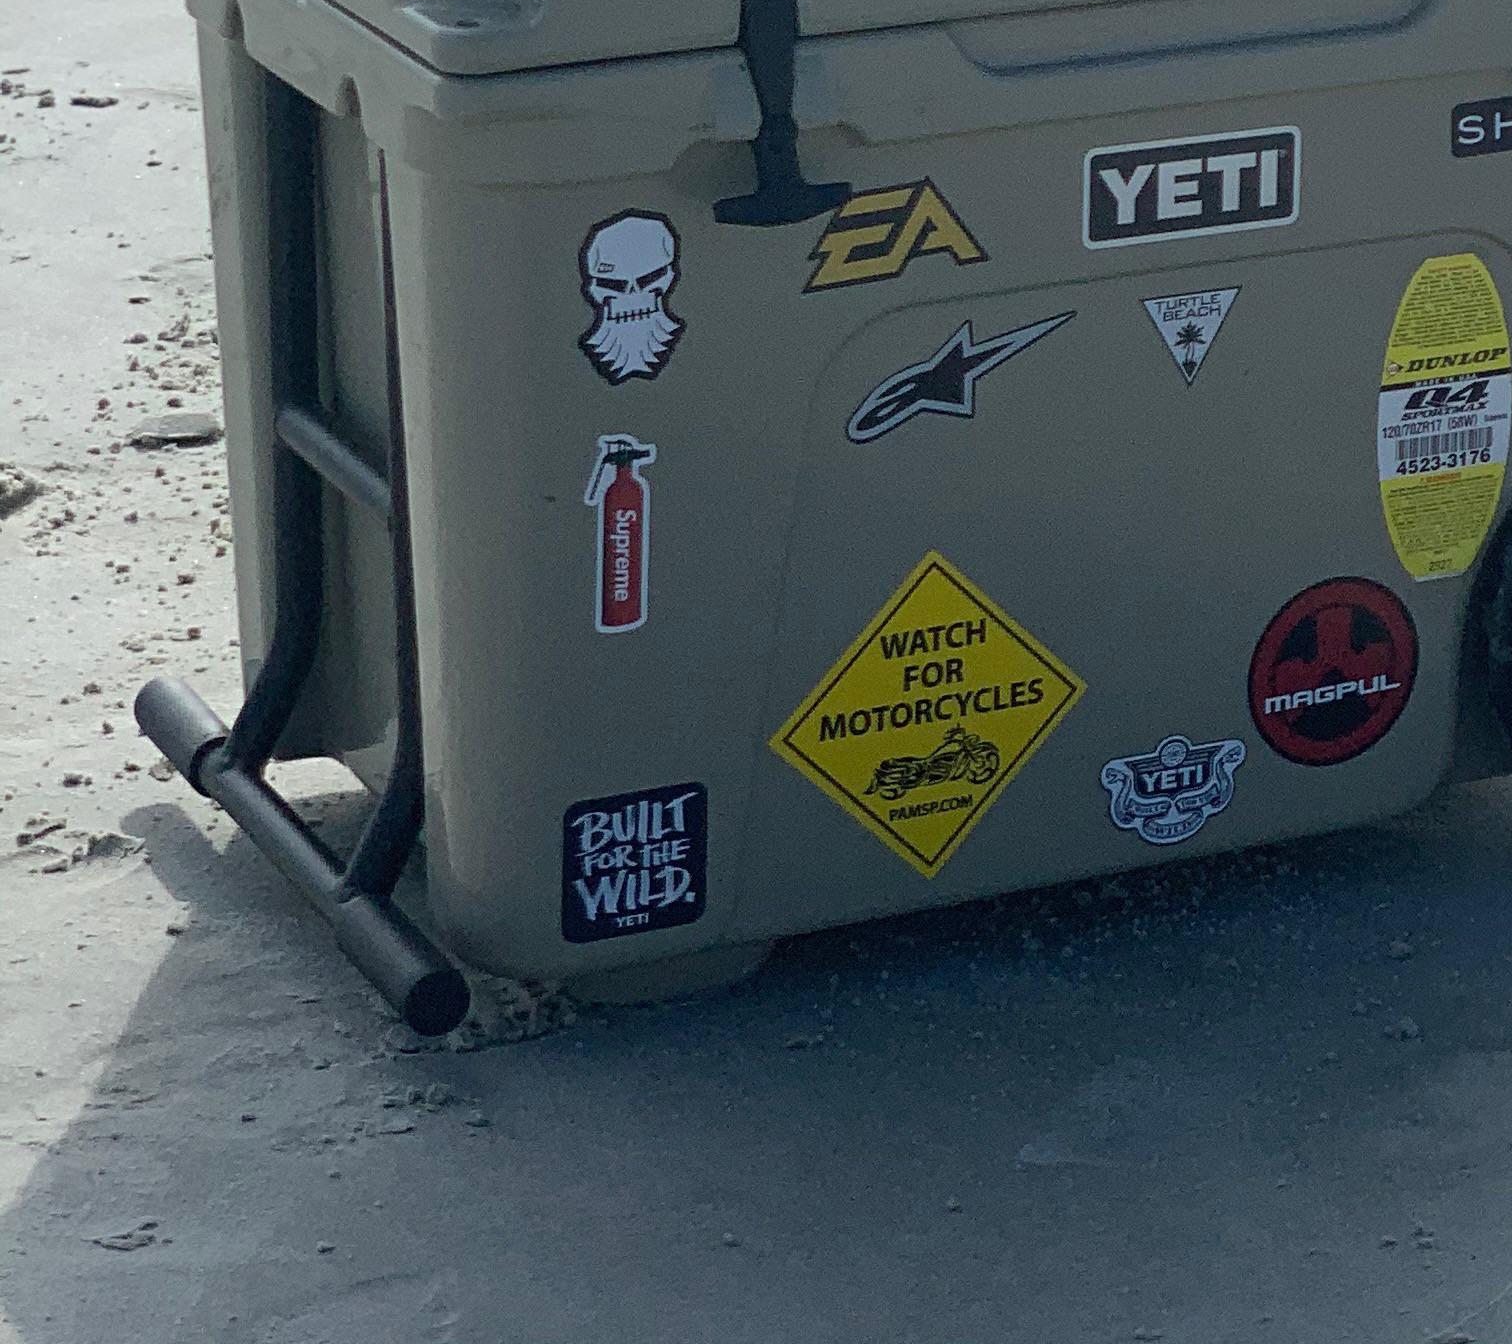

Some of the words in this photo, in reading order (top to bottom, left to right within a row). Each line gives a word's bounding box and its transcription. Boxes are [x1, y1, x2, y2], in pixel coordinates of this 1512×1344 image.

[1099, 149, 1279, 225] YETI
[806, 180, 987, 291] EA
[1153, 294, 1221, 312] TURTLE
[1163, 306, 1221, 322] BEACH
[1405, 347, 1508, 372] DUNLOP
[1404, 380, 1490, 409] Q4
[1400, 400, 1489, 421] SPORTMAX
[1396, 448, 1491, 474] 4523-3176
[614, 508, 636, 602] Supreme
[880, 620, 987, 661] WATCH
[902, 660, 964, 691] FOR
[1263, 674, 1400, 715] MAGPUL
[818, 681, 1045, 743] MOTORCYCLES
[1142, 764, 1203, 792] YETI
[889, 794, 973, 820] PAMSP.COM
[571, 792, 698, 856] BUILT
[582, 846, 637, 876] FOR
[640, 839, 691, 867] THE
[573, 866, 696, 920] WILD.
[616, 913, 649, 927] YETI
